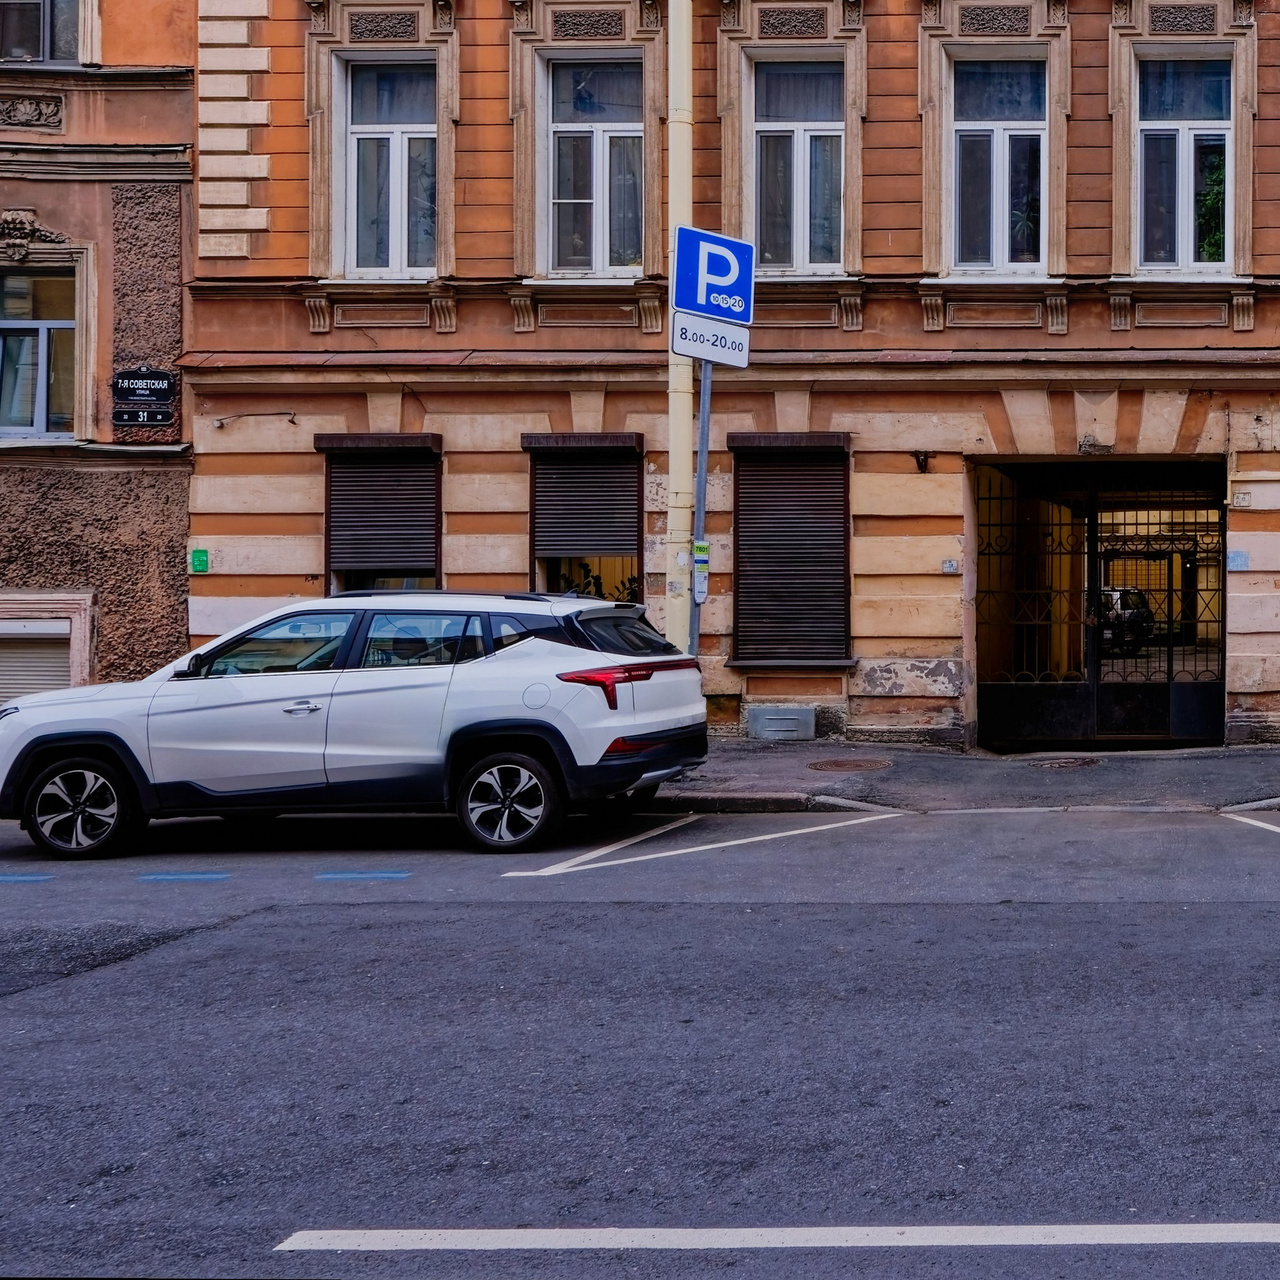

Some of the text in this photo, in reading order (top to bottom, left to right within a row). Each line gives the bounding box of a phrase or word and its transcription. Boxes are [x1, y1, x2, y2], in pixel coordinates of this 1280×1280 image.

[697, 241, 740, 305] P
[721, 296, 729, 304] 15
[731, 298, 743, 308] 20
[680, 327, 744, 352] 8.00-20.00
[118, 380, 168, 388] 7-Я СОВЕТСКАЯ
[138, 412, 147, 421] 31
